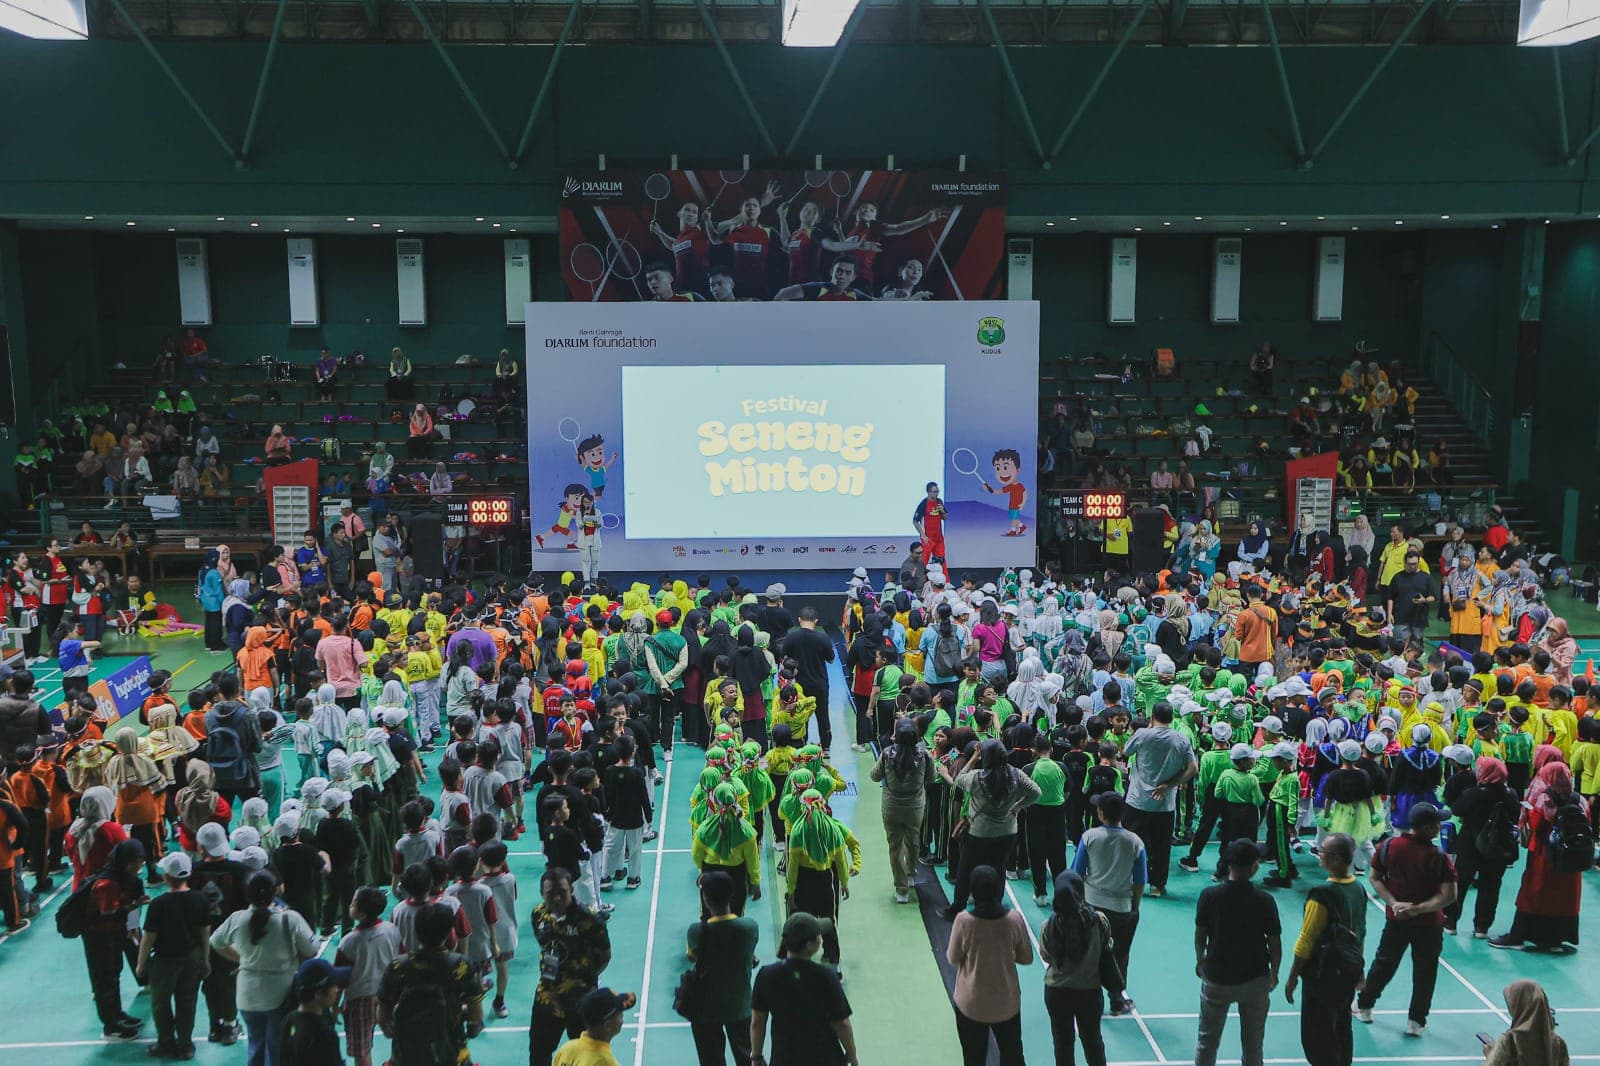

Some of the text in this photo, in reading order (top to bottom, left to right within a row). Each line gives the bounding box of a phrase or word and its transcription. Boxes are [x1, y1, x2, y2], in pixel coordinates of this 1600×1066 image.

[582, 181, 622, 191] DJARUM
[960, 182, 1000, 191] foundation
[545, 335, 656, 348] DJARUM foundation
[741, 394, 829, 417] Festival
[697, 420, 874, 463] Seneng
[705, 456, 865, 496] Minton
[447, 500, 507, 512] TEAM A 00:00
[1062, 496, 1077, 504] TEAM
[1086, 494, 1121, 506] 00:00
[447, 514, 463, 522] TEAM
[472, 511, 508, 523] 00:00
[1062, 507, 1077, 515] TEAM
[1086, 505, 1121, 517] 00:00
